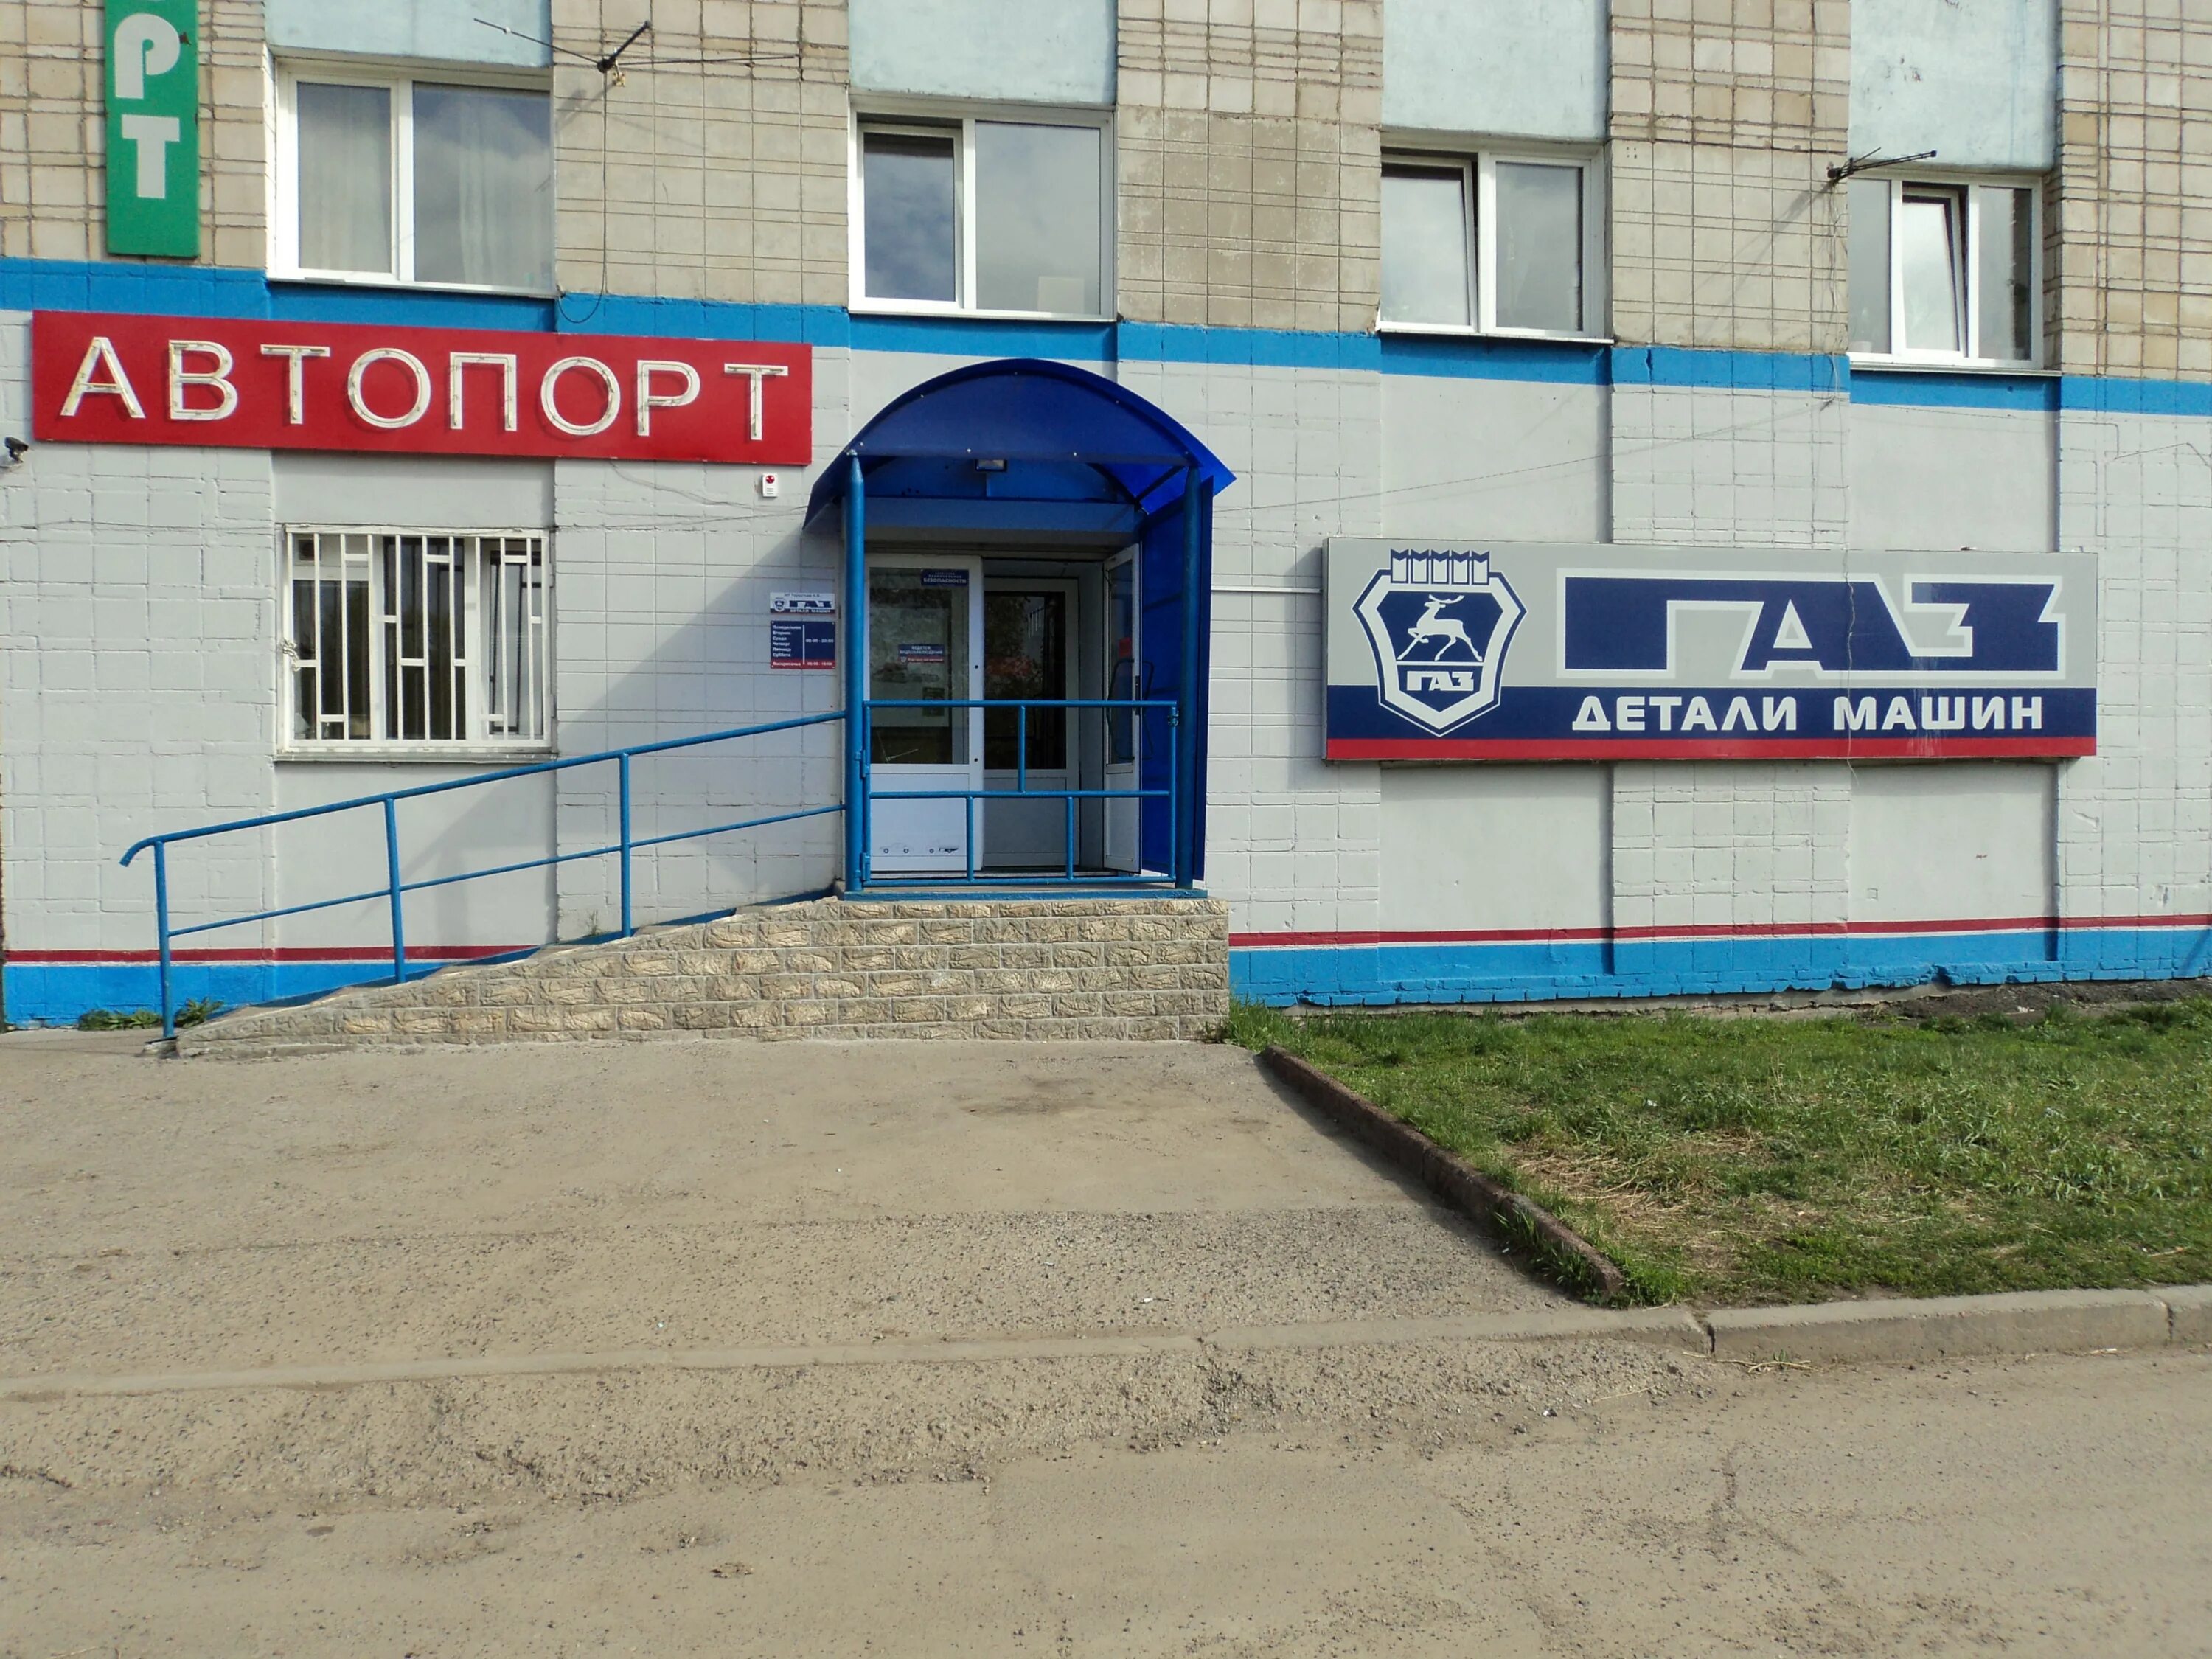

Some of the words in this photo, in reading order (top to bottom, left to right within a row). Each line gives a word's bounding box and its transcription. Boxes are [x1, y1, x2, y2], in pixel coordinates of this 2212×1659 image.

[60, 336, 789, 441] АВТОПОРТ
[789, 599, 832, 608] ГАЗ
[1557, 568, 2065, 680] ГАЗ
[1406, 671, 1474, 692] ГАЗ
[1572, 695, 1798, 732] ДЕТАЛИ
[1833, 695, 2043, 731] МАШИН
